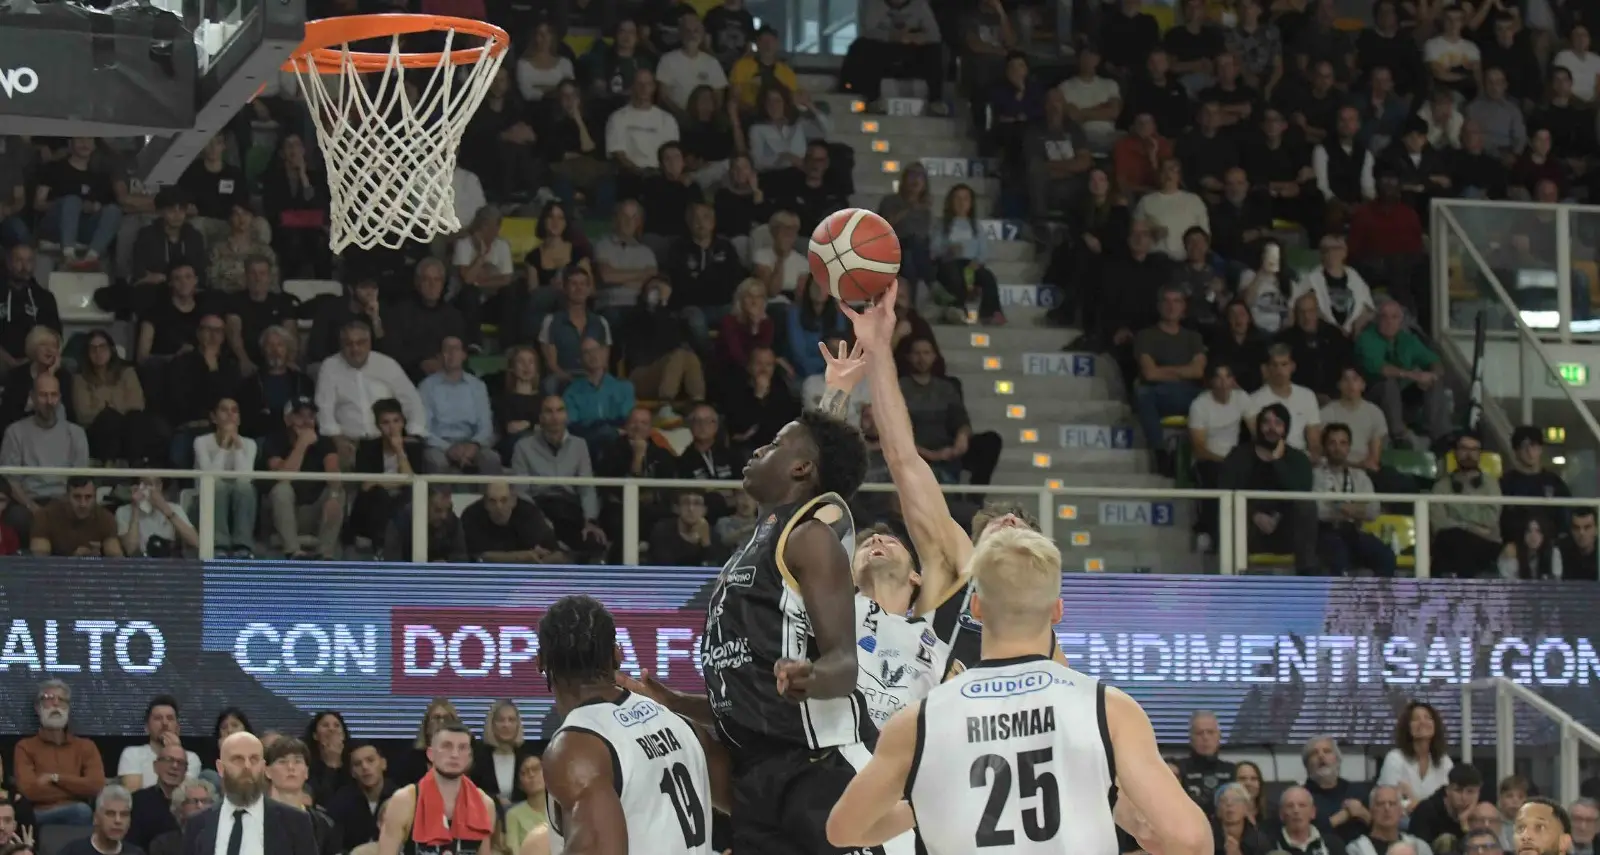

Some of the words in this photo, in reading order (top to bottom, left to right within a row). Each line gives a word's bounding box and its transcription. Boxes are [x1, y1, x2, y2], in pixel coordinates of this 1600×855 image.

[1029, 356, 1070, 375] FILA
[1077, 357, 1091, 375] 5
[1066, 428, 1109, 448] FILA
[1105, 503, 1148, 523] FILA
[1156, 504, 1169, 524] 3
[0, 619, 166, 673] ALTO
[234, 622, 377, 676] CON
[970, 675, 1043, 694] GIUDICI
[966, 705, 1056, 743] RIISMAA
[969, 746, 1062, 848] 25
